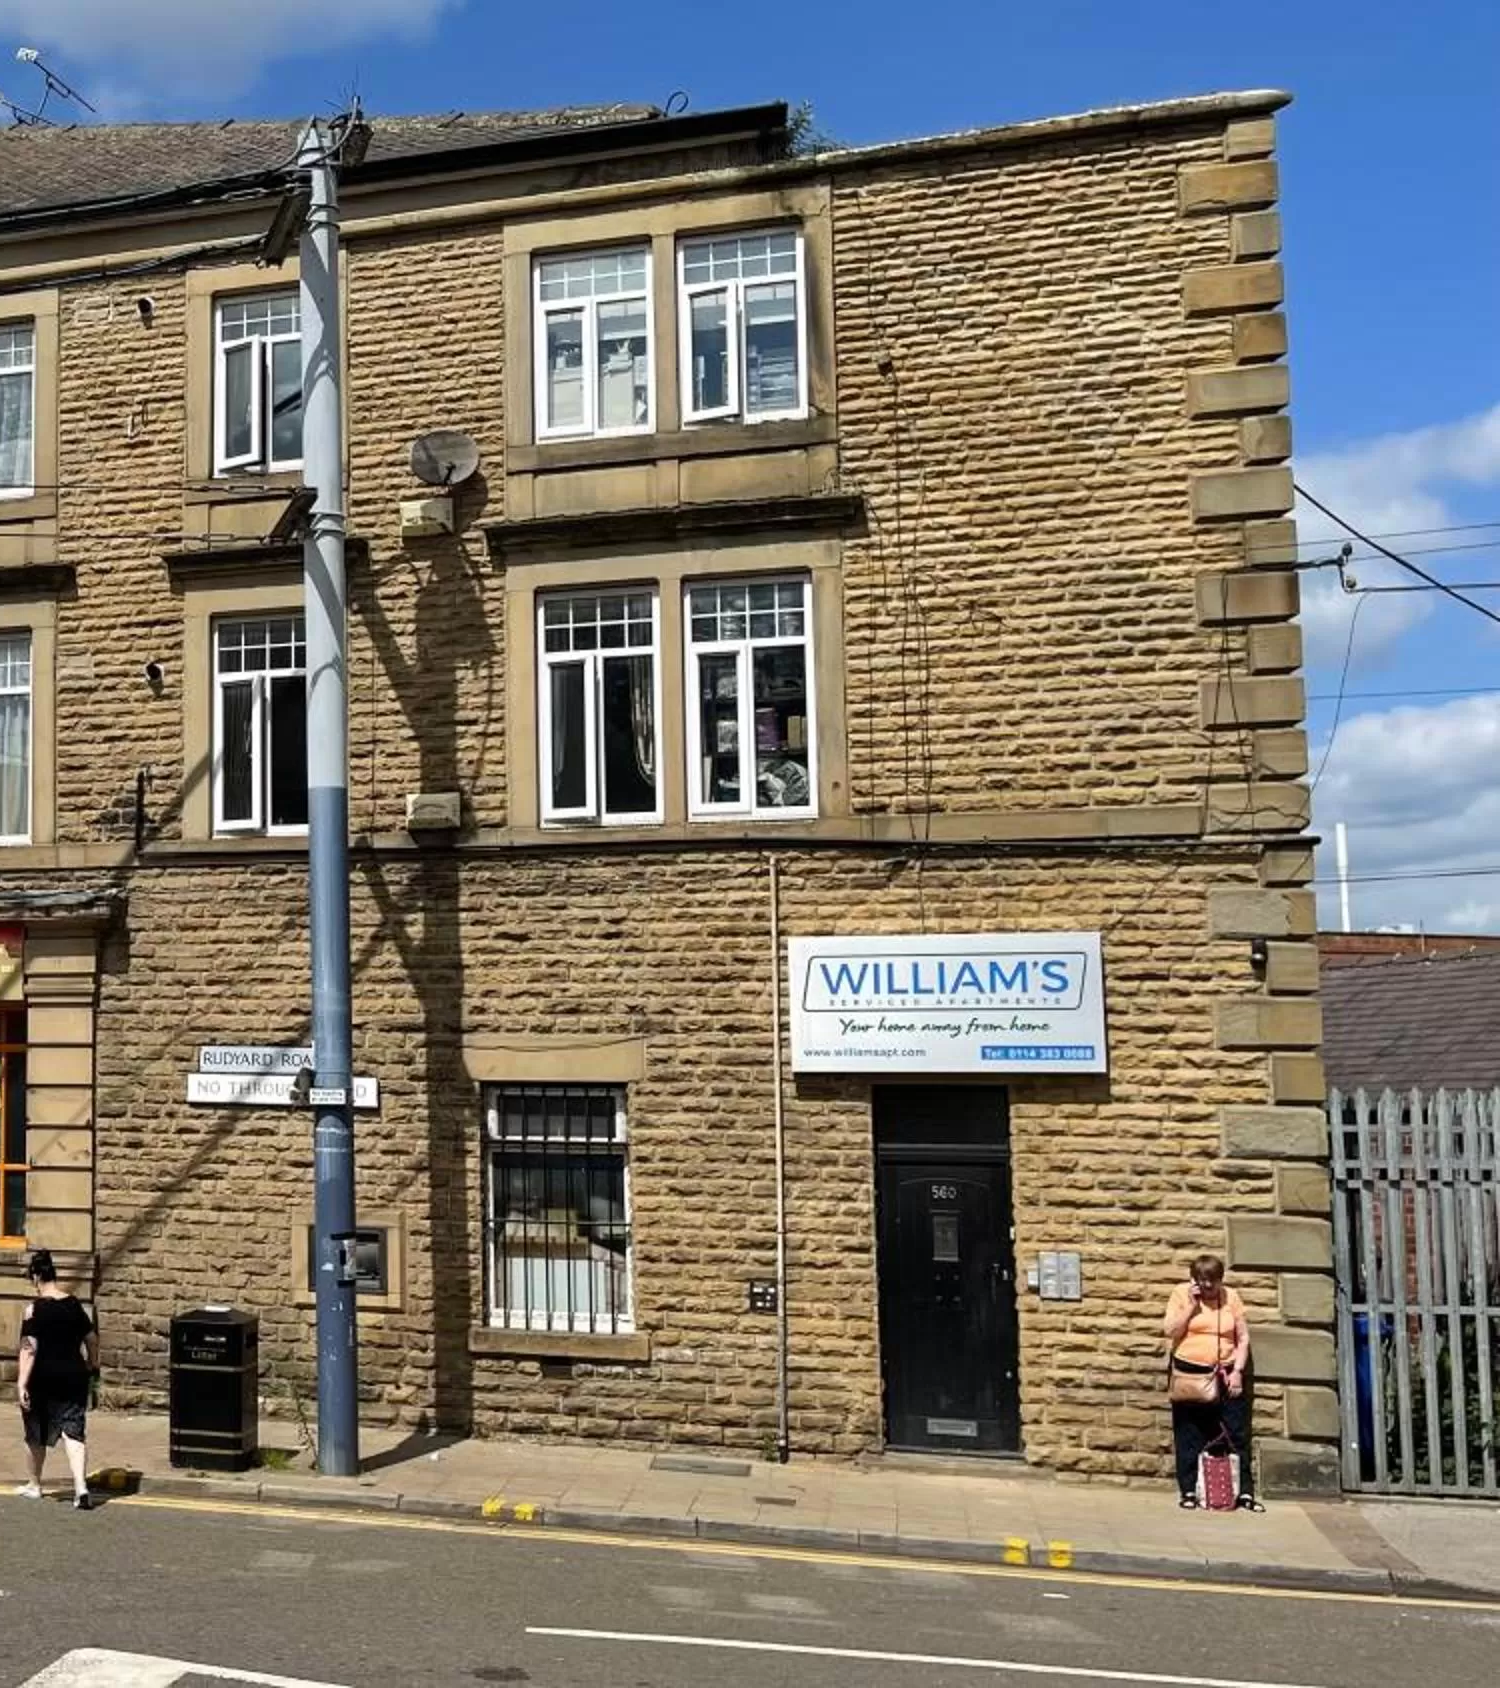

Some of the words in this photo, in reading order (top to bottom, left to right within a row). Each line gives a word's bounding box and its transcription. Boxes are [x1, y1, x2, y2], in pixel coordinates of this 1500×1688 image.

[819, 960, 1070, 996] WILLIAM'S
[935, 997, 1061, 1006] APARTMENTS
[838, 1017, 874, 1036] Your
[877, 1016, 916, 1032] home
[921, 1022, 962, 1038] away
[965, 1017, 1007, 1036] from
[1009, 1015, 1052, 1031] home
[202, 1051, 274, 1066] RUDYARD
[280, 1053, 314, 1067] ROA
[197, 1081, 221, 1095] NO
[931, 1185, 957, 1199] 560
